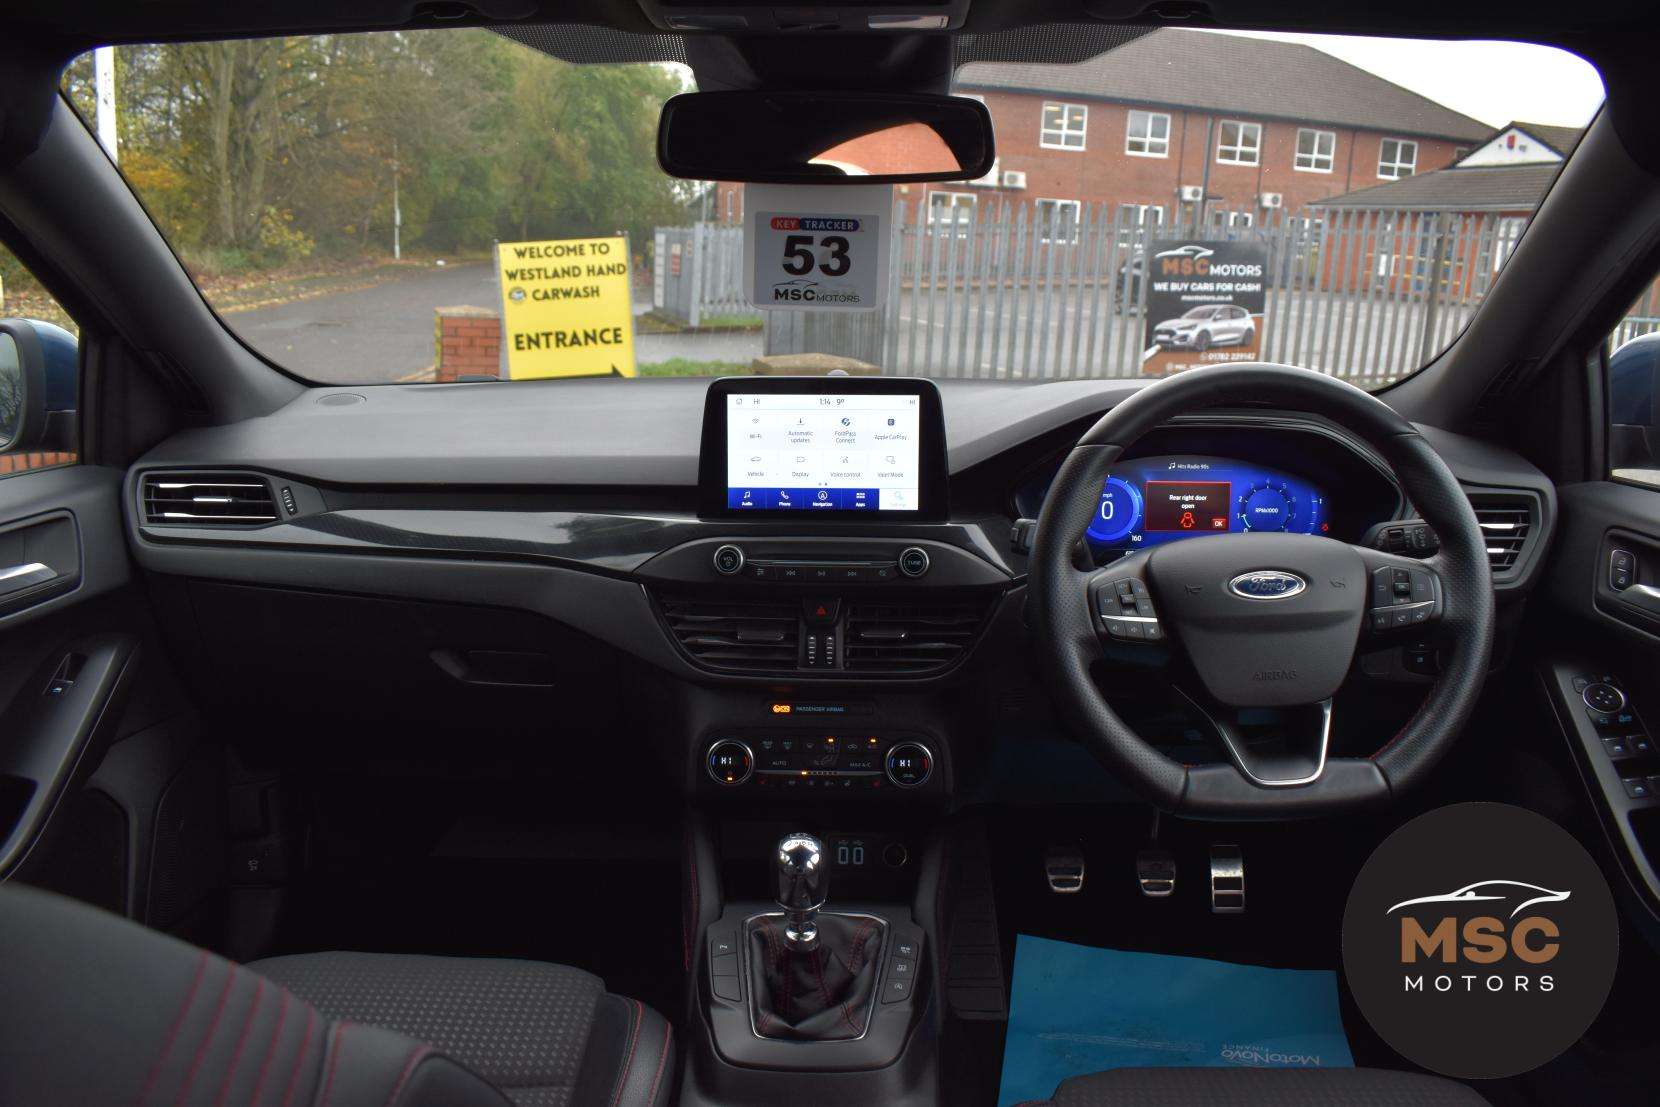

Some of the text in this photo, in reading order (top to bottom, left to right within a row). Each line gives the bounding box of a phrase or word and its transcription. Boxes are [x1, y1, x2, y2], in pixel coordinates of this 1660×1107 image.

[775, 218, 855, 230] KEY TRACKER
[514, 242, 610, 259] WELCOME TO
[782, 235, 852, 277] 53
[505, 263, 627, 281] WESTLAND HAND
[1162, 258, 1262, 277] MSC MOTORS
[532, 286, 600, 301] CARWASH
[774, 288, 862, 303] MSC MOTORS
[1153, 282, 1261, 292] WE BUY CARS FOR CASH!
[514, 327, 623, 351] ENTRANCE
[1101, 501, 1114, 520] 0
[1248, 576, 1288, 592] Ford
[1252, 670, 1298, 681] AIRBAG
[1221, 1048, 1320, 1066] MotoNovo
